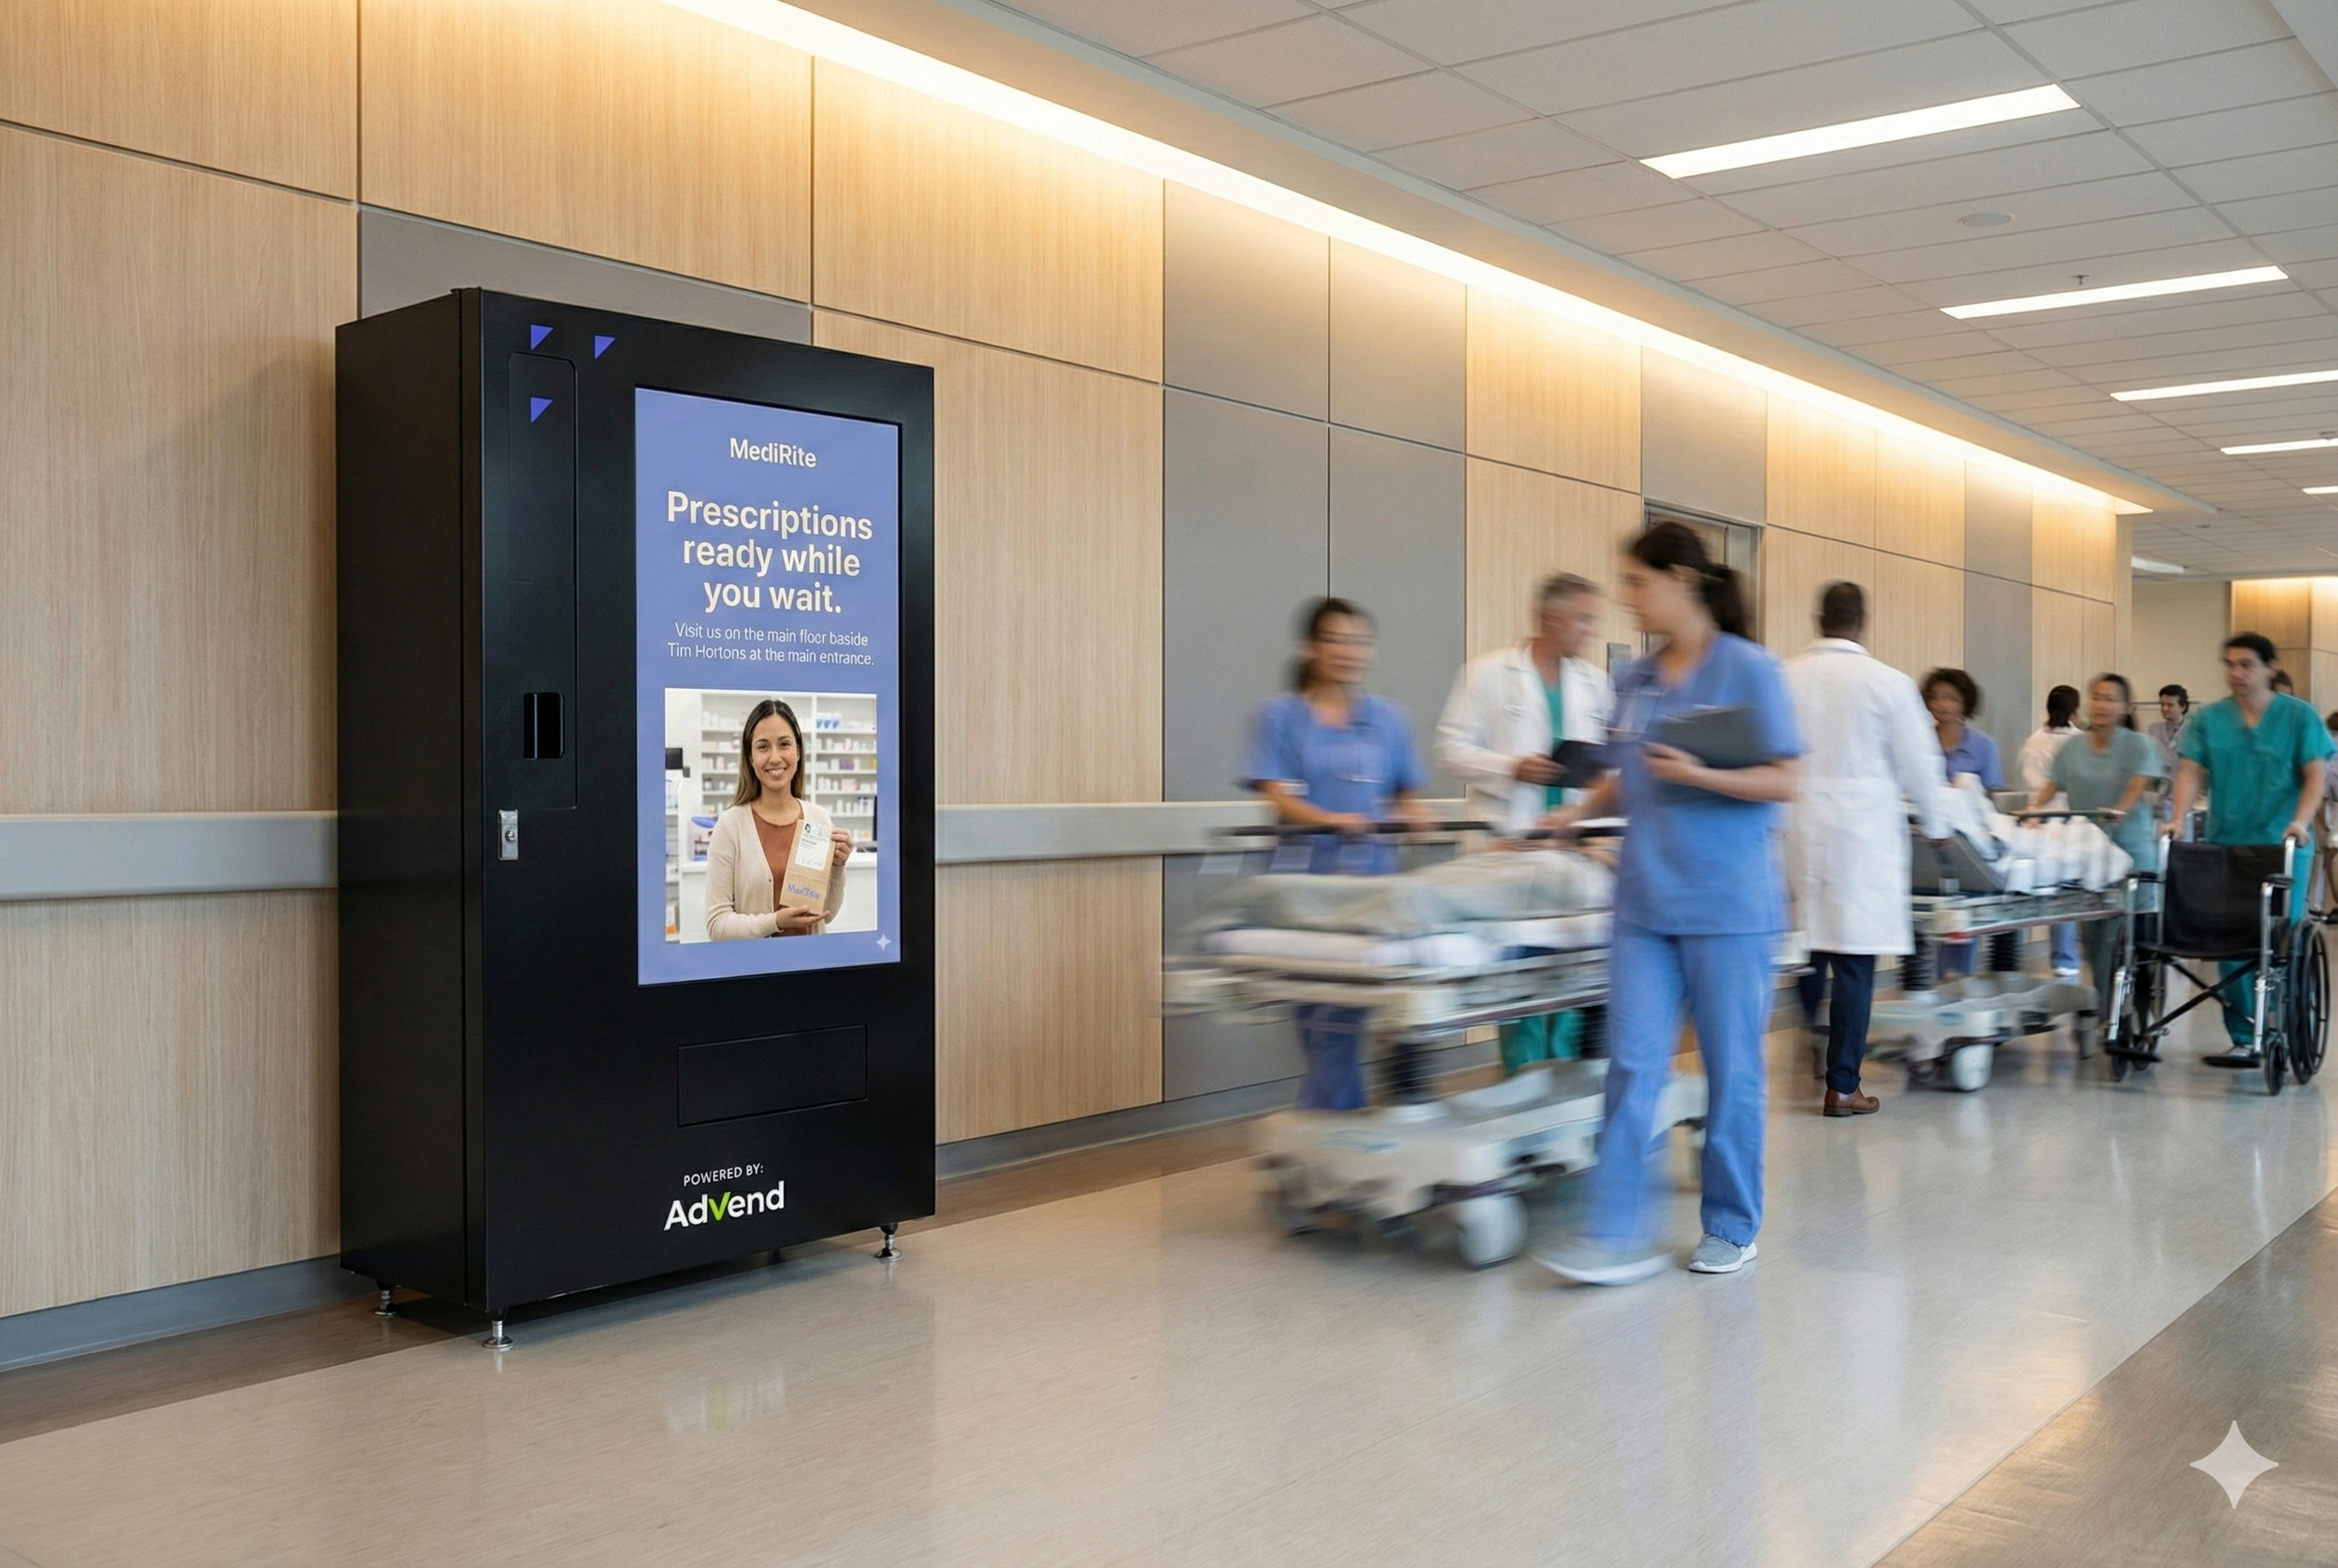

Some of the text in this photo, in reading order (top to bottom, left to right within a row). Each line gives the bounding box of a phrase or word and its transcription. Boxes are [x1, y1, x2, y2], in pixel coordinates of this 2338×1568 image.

[729, 437, 816, 468] MediRite
[668, 490, 873, 540] Prescriptions
[684, 539, 860, 577] ready while
[703, 581, 841, 613] you wait.
[706, 627, 722, 640] us
[724, 628, 741, 640] on
[743, 626, 765, 641] the
[767, 627, 797, 643] main
[667, 642, 875, 666] Tim Hortons at the main entrance.
[683, 1162, 764, 1187] POWERED BY:
[663, 1180, 786, 1231] AdVend
